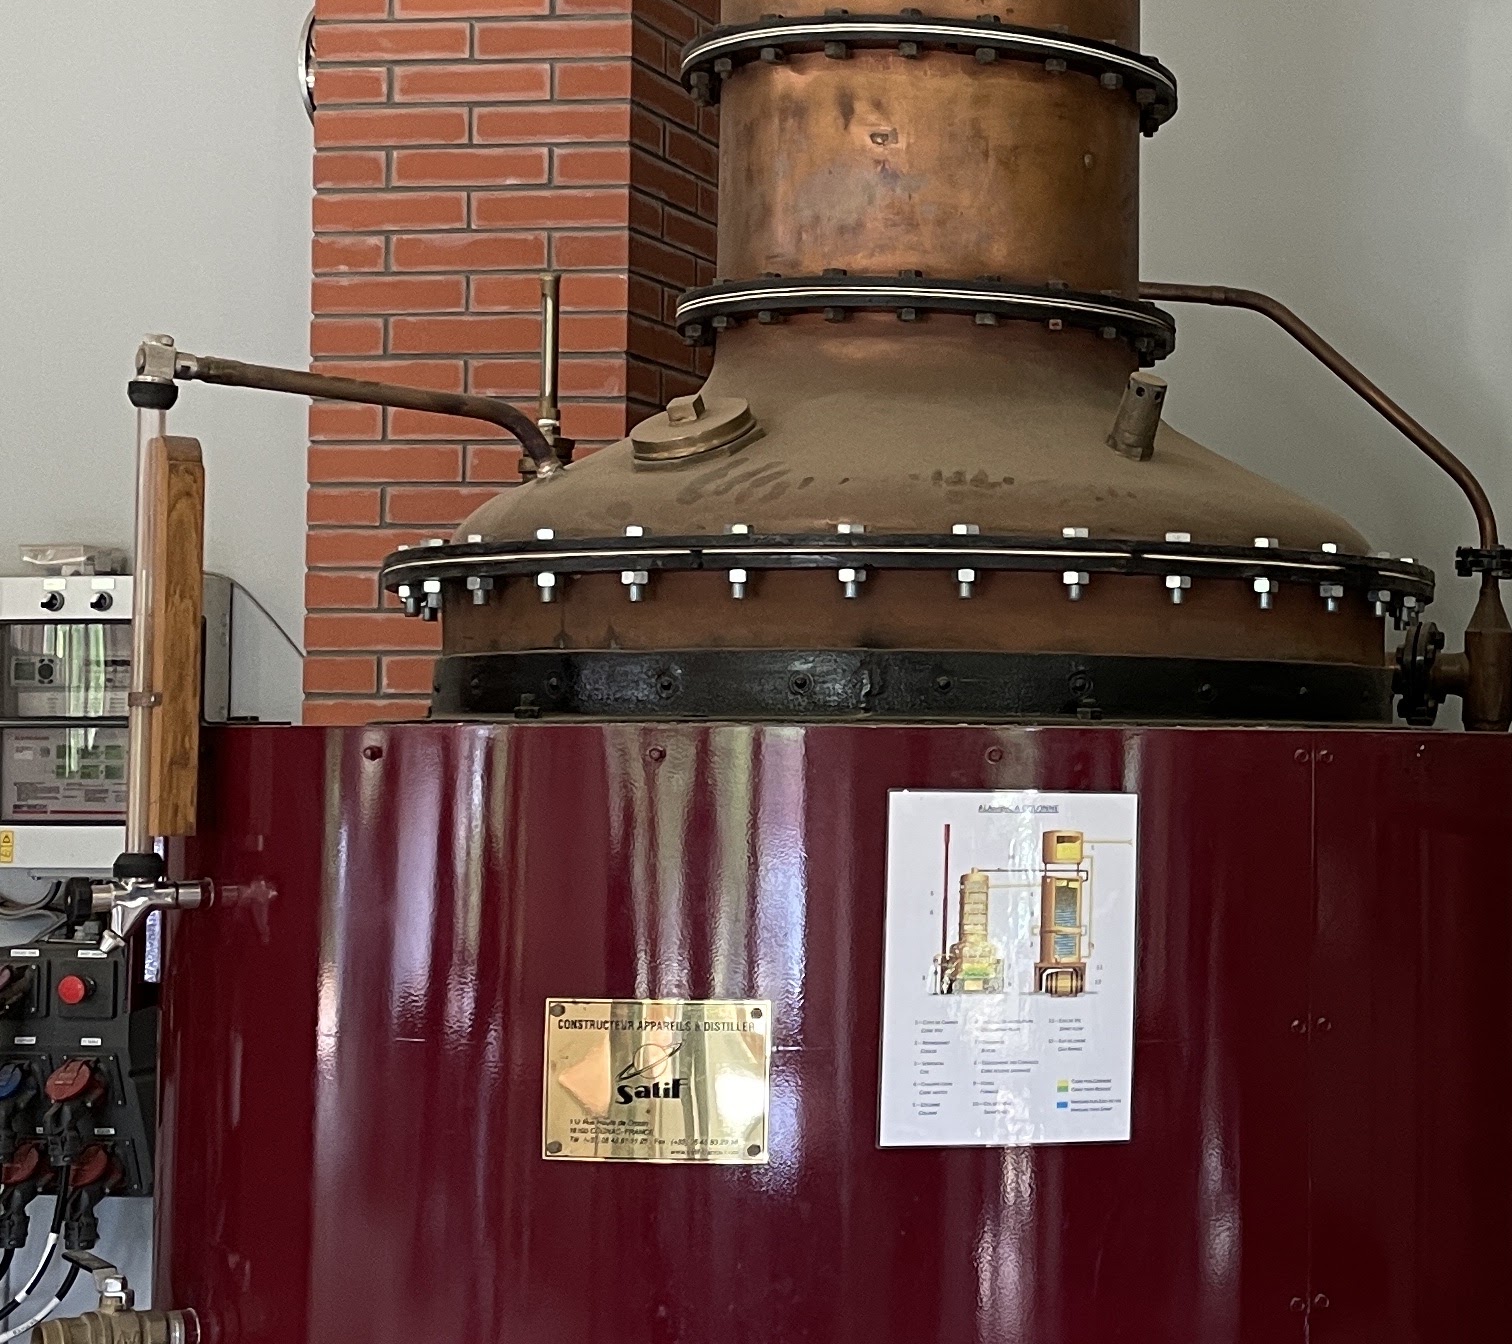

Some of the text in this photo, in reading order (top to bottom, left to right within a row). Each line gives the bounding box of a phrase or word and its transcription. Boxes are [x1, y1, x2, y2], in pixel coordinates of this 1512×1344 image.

[558, 1018, 634, 1031] CONSTRUCTEUR
[636, 1019, 691, 1032] APPAREILS
[704, 1020, 755, 1032] DISTILLER
